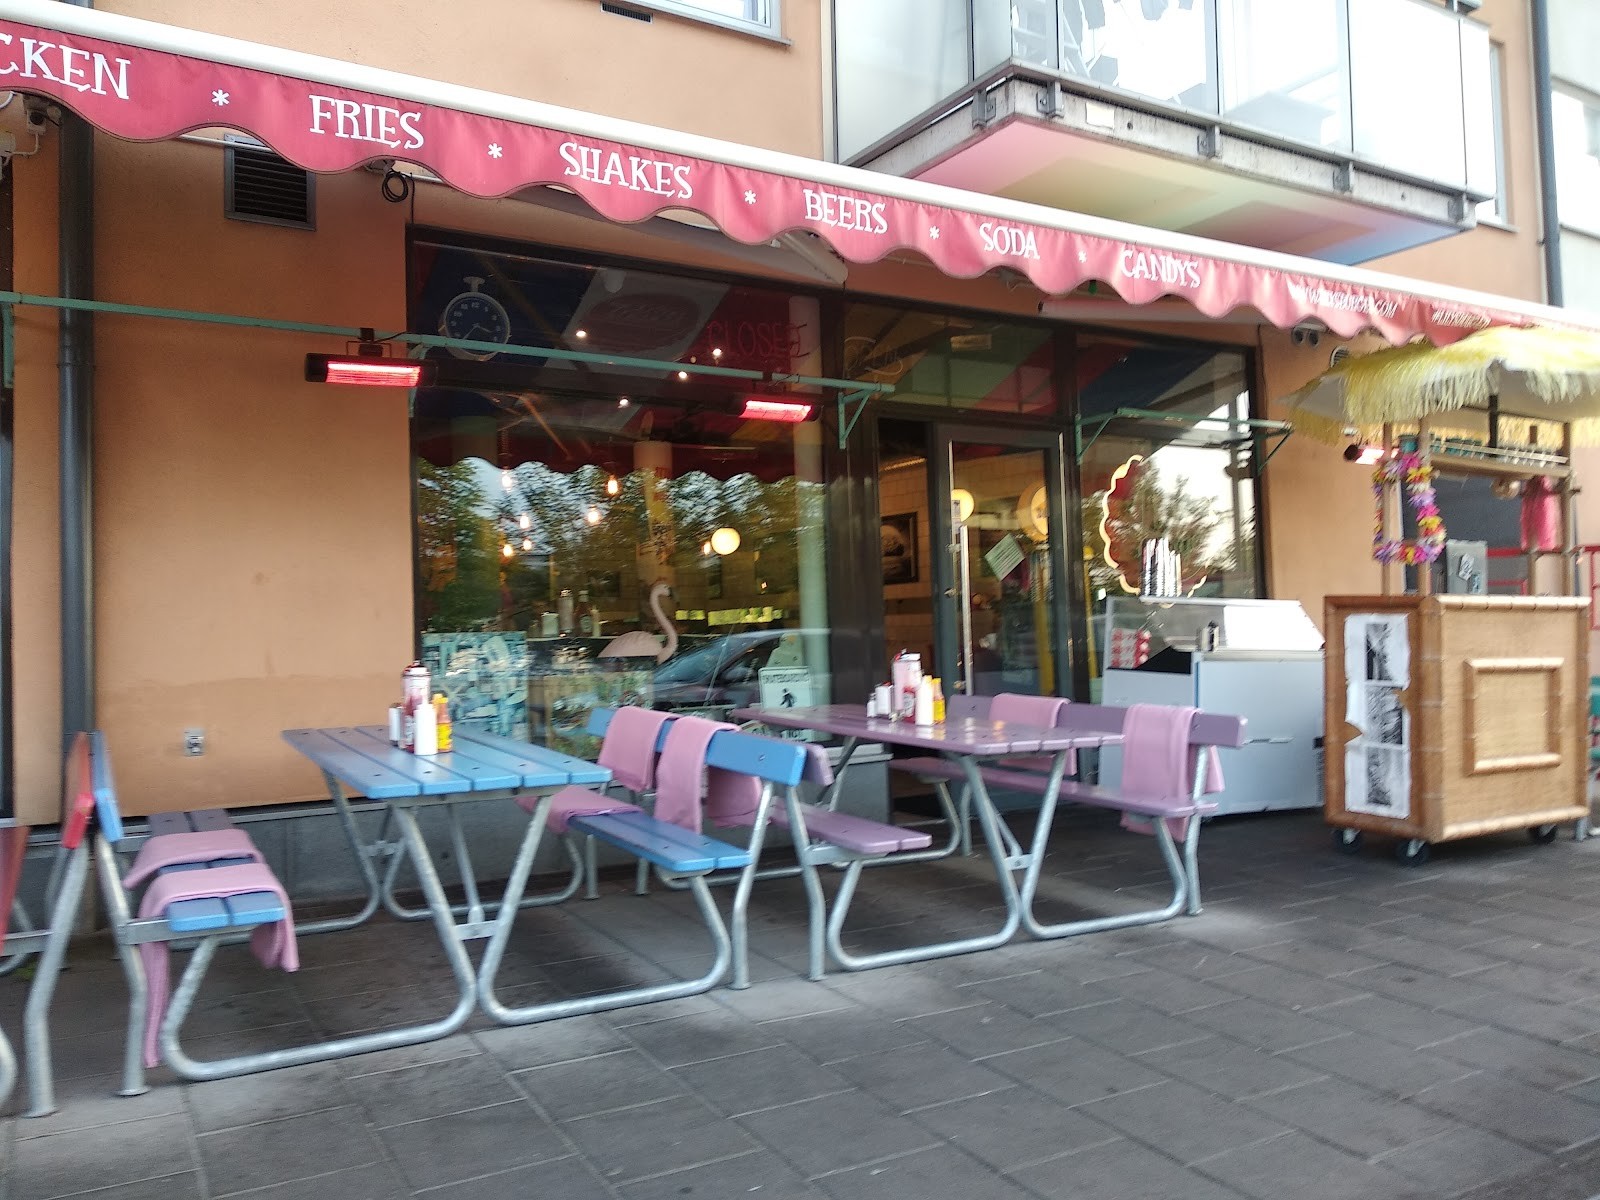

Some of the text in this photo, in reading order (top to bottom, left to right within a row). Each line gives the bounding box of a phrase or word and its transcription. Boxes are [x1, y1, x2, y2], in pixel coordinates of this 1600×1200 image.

[309, 94, 424, 150] FRIES
[559, 141, 693, 199] SHAKES
[804, 189, 888, 234] BEERS
[979, 222, 1040, 260] SODA
[1120, 247, 1200, 289] CANDYS
[708, 320, 802, 359] CLOSED
